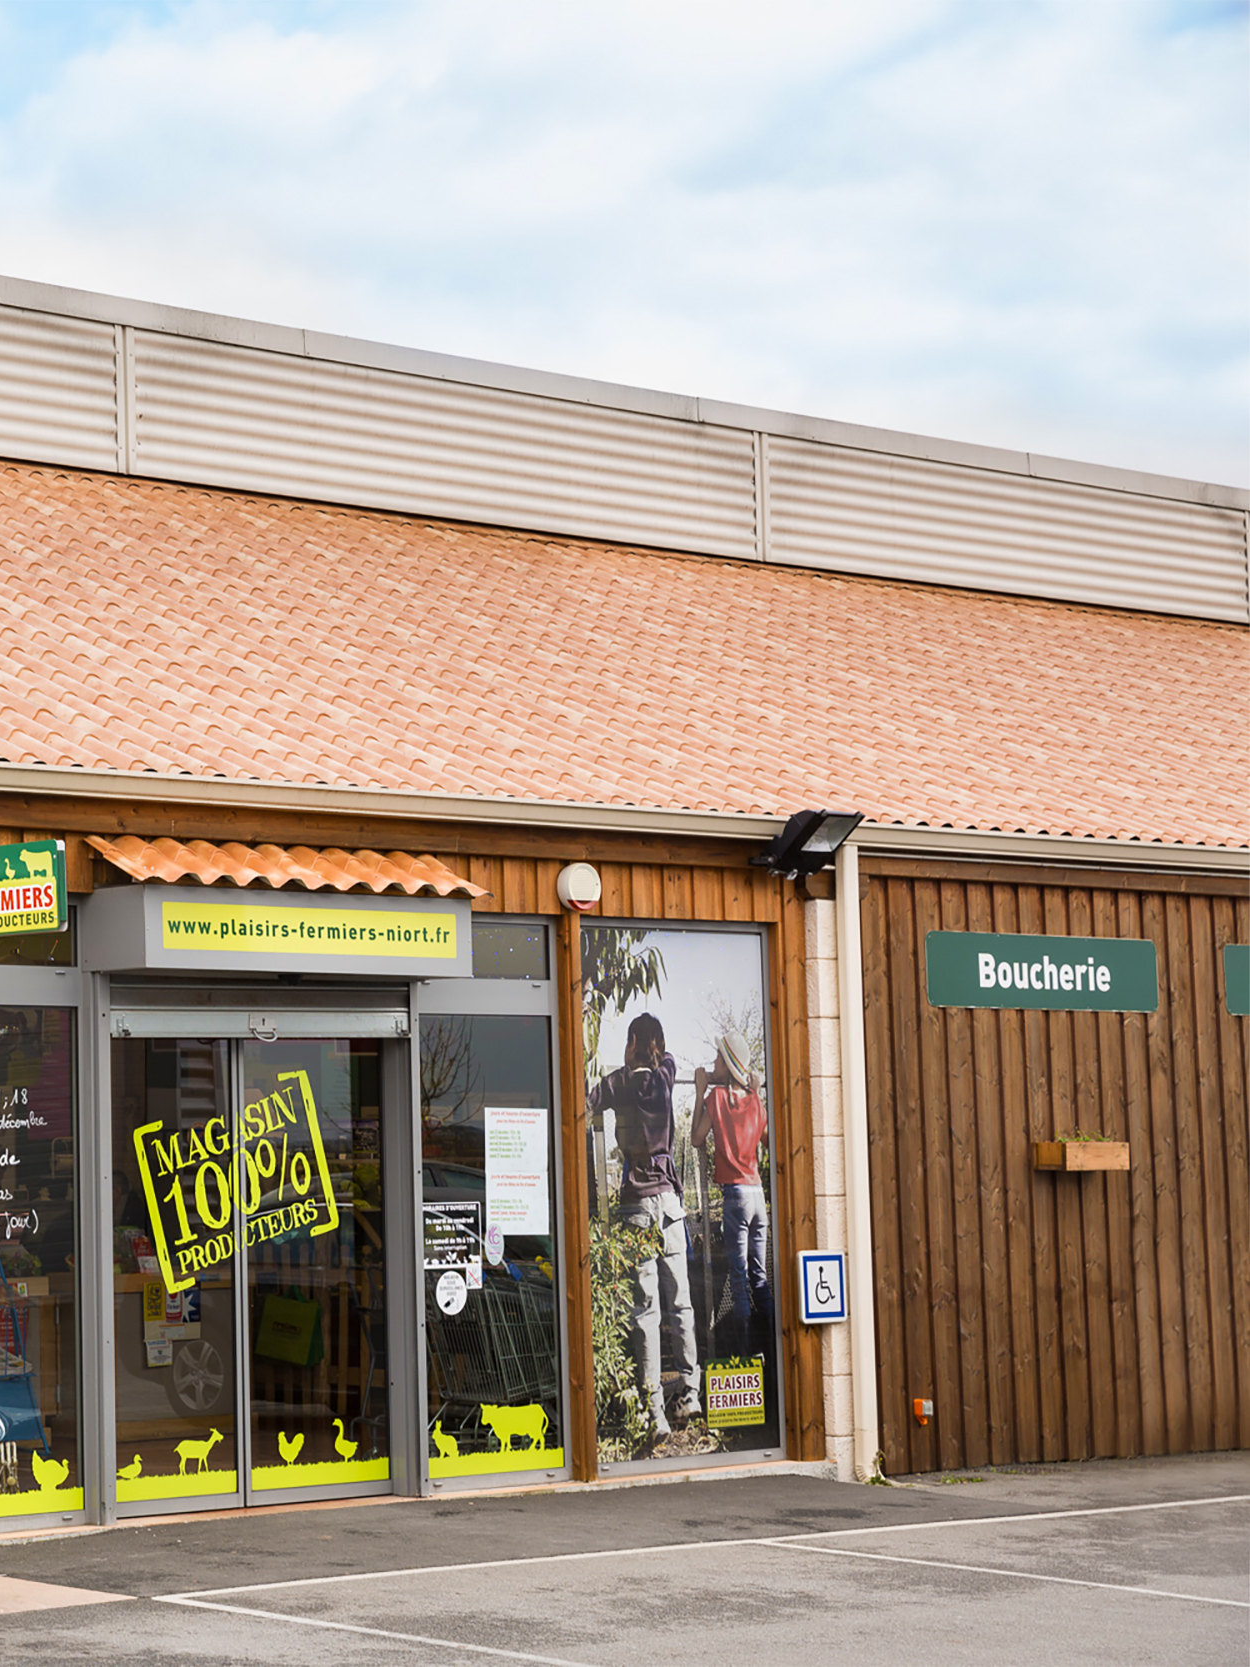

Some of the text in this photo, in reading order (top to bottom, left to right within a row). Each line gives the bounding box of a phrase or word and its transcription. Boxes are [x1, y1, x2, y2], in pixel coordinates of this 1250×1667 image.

[167, 915, 450, 946] www.plaisirs-fermiers-niort.fr
[977, 952, 1112, 992] Boucherie
[151, 1086, 297, 1177] MAGASIN
[0, 1148, 21, 1166] de
[163, 1132, 311, 1246] 100%
[175, 1198, 319, 1276] PRODUCTEURS
[708, 1391, 763, 1409] FERMIERS
[710, 1374, 760, 1391] PLAISIRS
